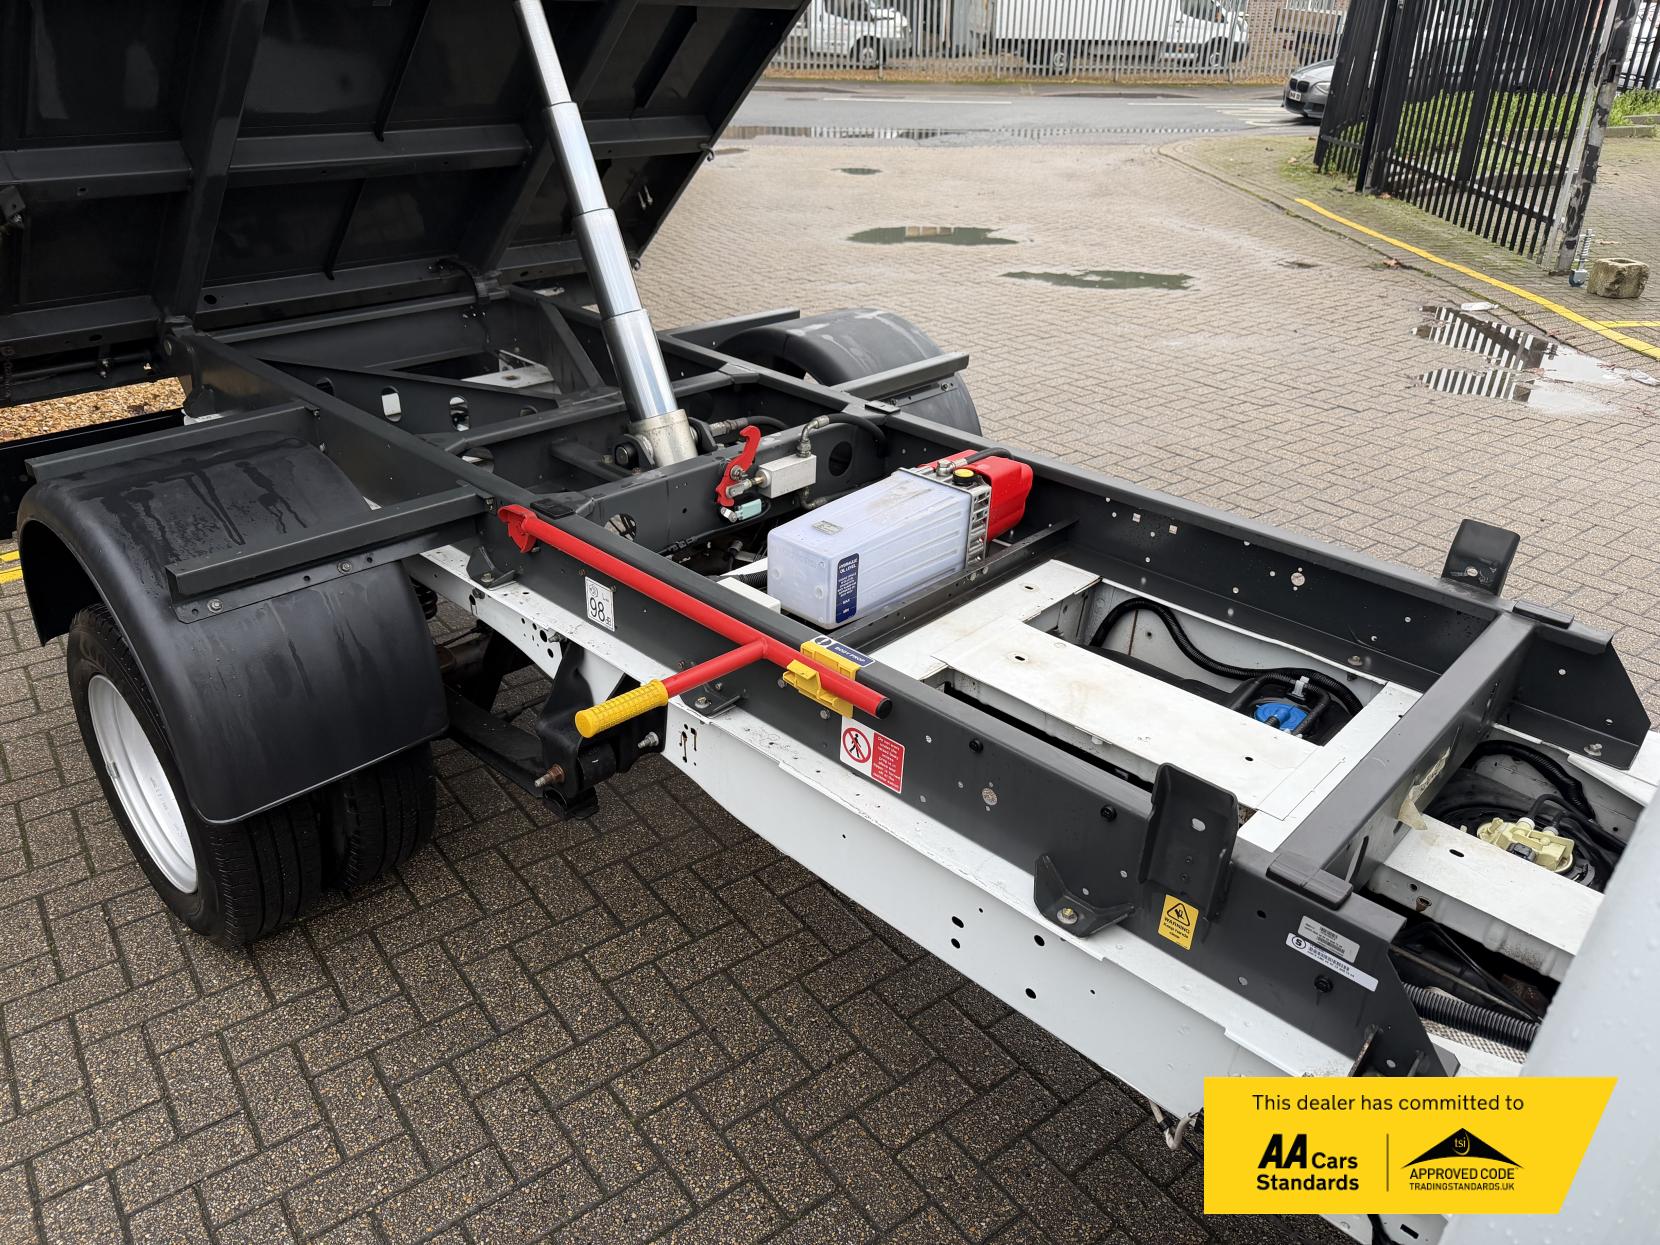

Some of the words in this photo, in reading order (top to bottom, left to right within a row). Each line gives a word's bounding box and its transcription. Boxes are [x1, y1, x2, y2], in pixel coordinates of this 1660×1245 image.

[590, 597, 605, 622] 98
[1163, 922, 1175, 931] Keep
[1165, 917, 1190, 934] WARNING
